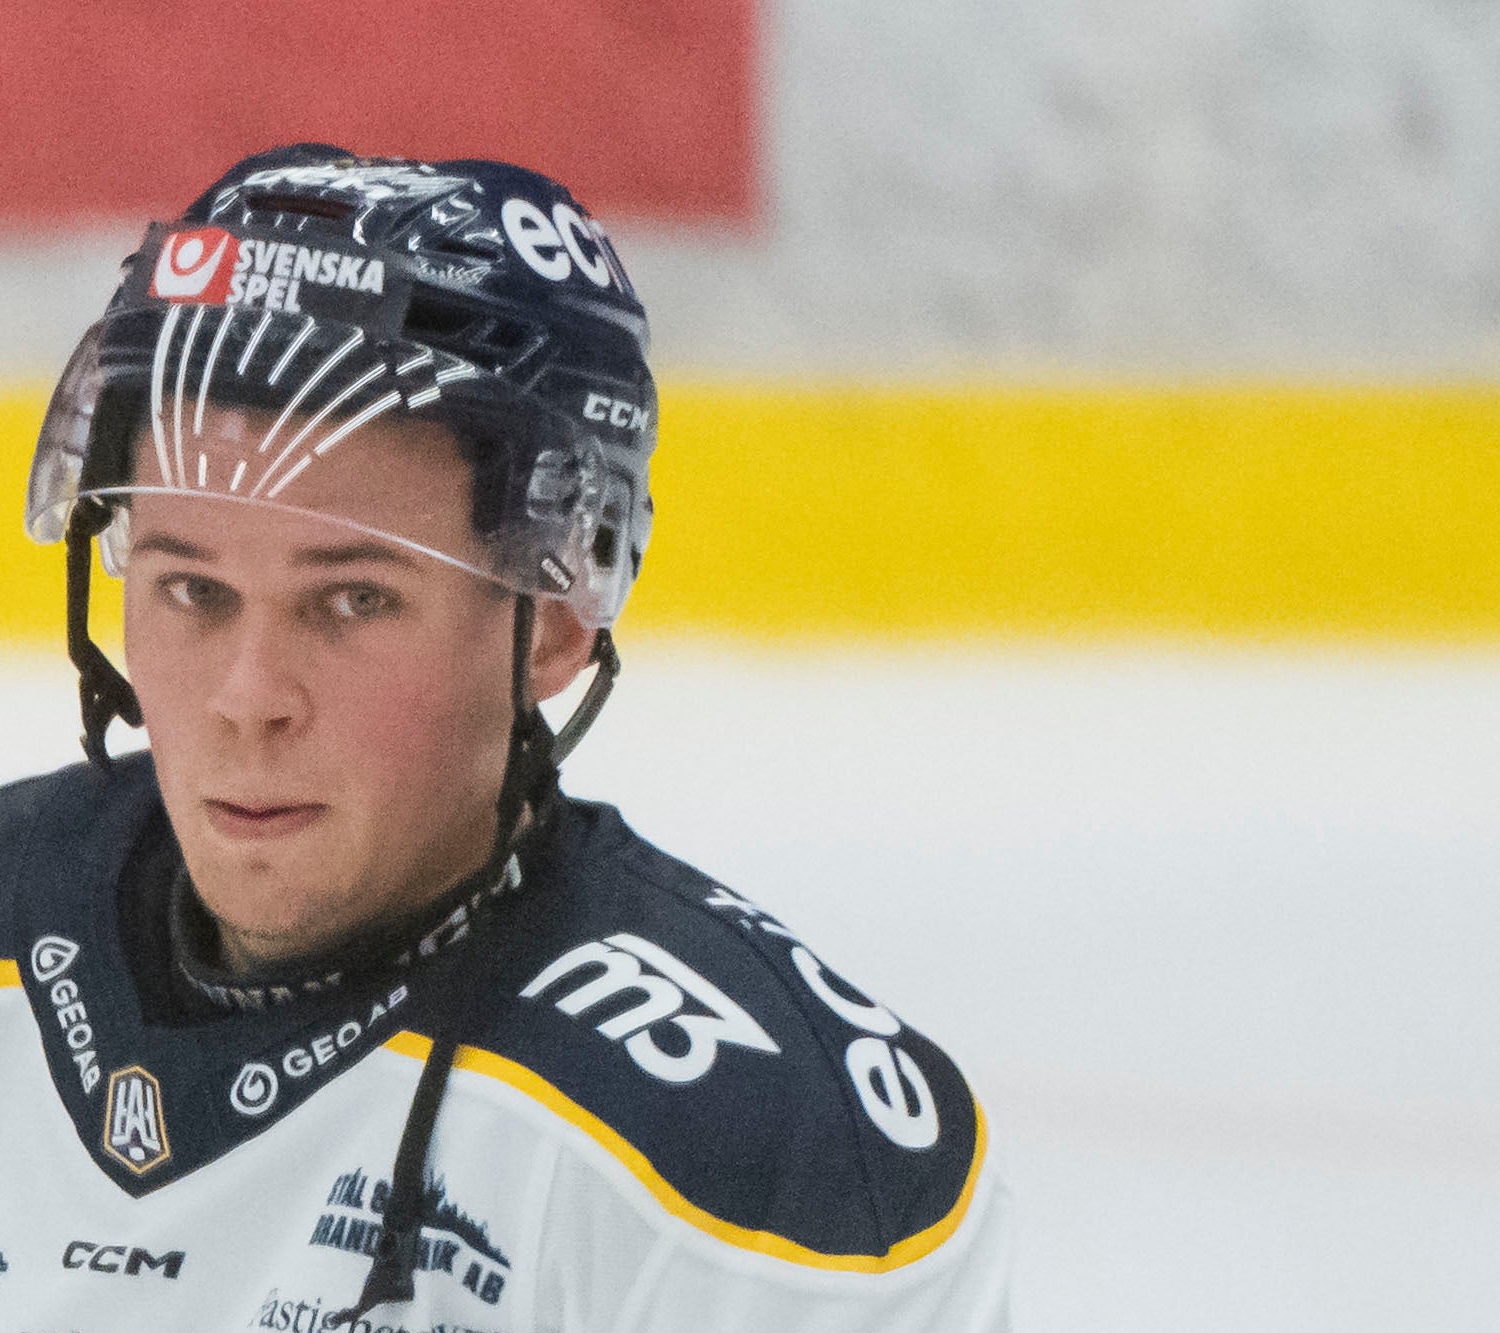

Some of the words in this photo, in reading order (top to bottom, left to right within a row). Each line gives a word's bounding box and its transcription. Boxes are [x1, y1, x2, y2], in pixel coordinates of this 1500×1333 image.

[236, 239, 386, 295] SVENSKA
[226, 273, 301, 313] SPEL
[582, 391, 650, 431] CCM
[50, 978, 94, 1051] GEO
[282, 1021, 363, 1078] GEO
[367, 984, 410, 1028] AB
[62, 1240, 187, 1281] CCM
[462, 1261, 506, 1306] AB
